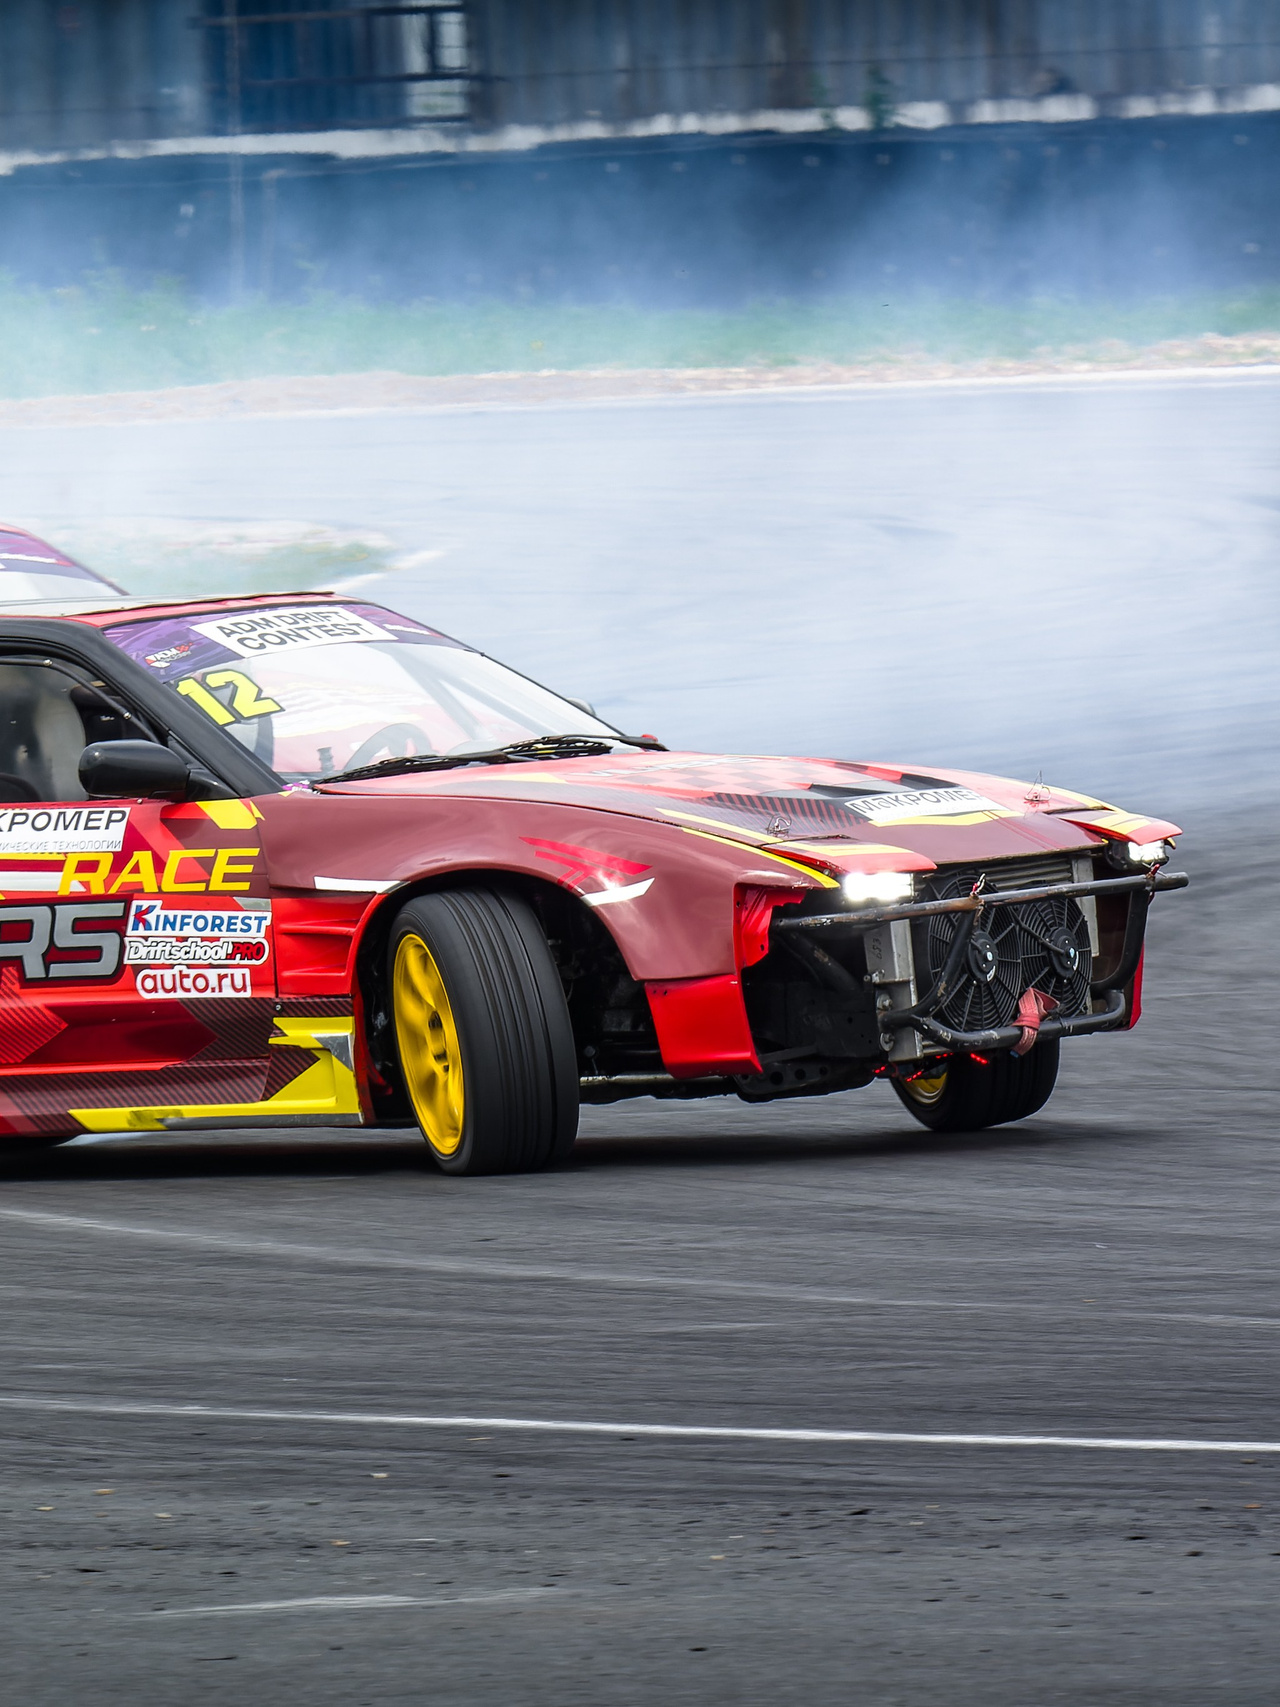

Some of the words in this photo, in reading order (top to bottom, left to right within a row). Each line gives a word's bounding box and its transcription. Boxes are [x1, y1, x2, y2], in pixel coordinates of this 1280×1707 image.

[216, 617, 281, 638] ADM
[272, 611, 349, 626] DRIFT
[236, 622, 373, 650] CONTEST
[173, 668, 285, 727] 12
[53, 839, 122, 851] ТЕХНОЛОГИИ
[57, 847, 261, 896] RACE
[131, 904, 268, 934] KINFOREST
[140, 969, 248, 994] auto.ru
